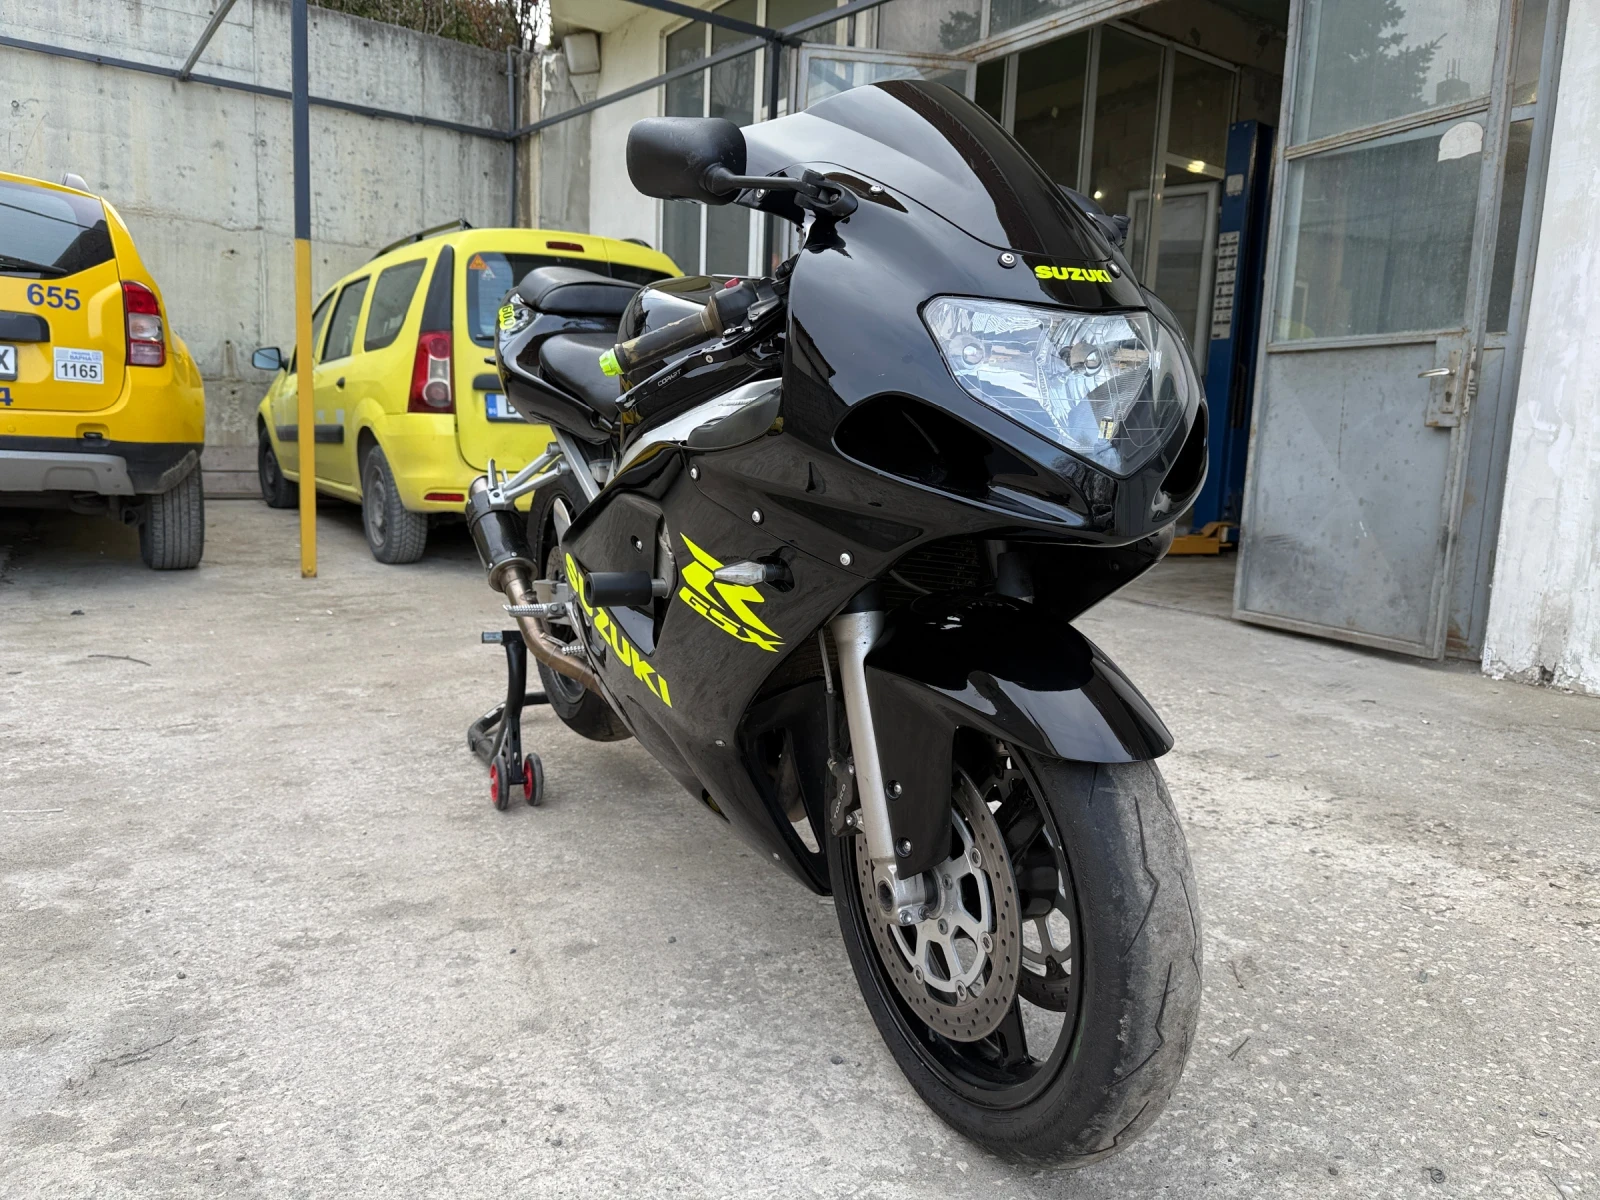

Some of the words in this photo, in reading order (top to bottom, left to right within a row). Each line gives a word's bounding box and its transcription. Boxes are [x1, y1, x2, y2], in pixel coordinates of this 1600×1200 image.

[1034, 265, 1113, 283] SUZUKI
[27, 283, 81, 311] 655
[501, 304, 515, 327] 600
[61, 363, 98, 379] 1165
